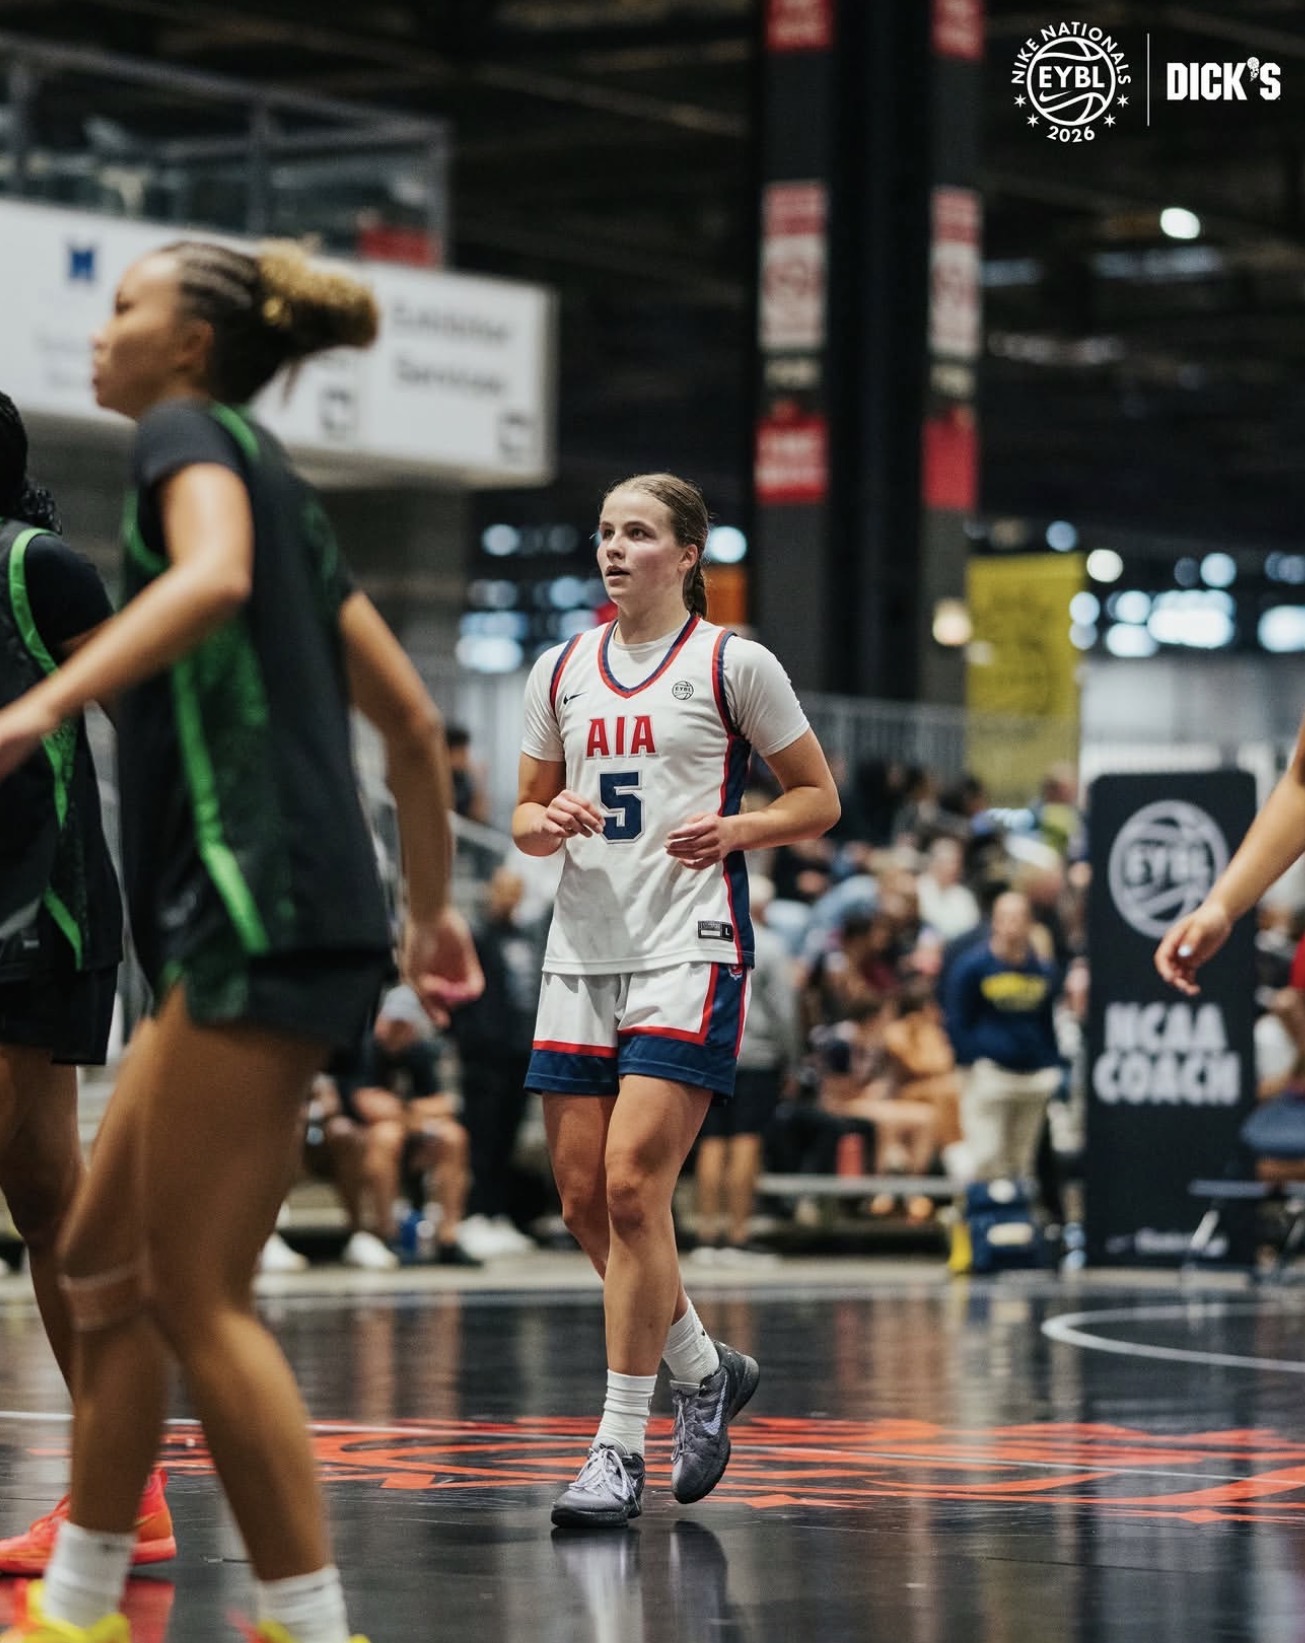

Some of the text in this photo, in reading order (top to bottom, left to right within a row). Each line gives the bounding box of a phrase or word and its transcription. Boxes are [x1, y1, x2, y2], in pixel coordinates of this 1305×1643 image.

[585, 715, 659, 759] AIA
[597, 770, 646, 845] 5
[1104, 1002, 1228, 1050] NCAA
[1093, 1051, 1241, 1105] COACH
